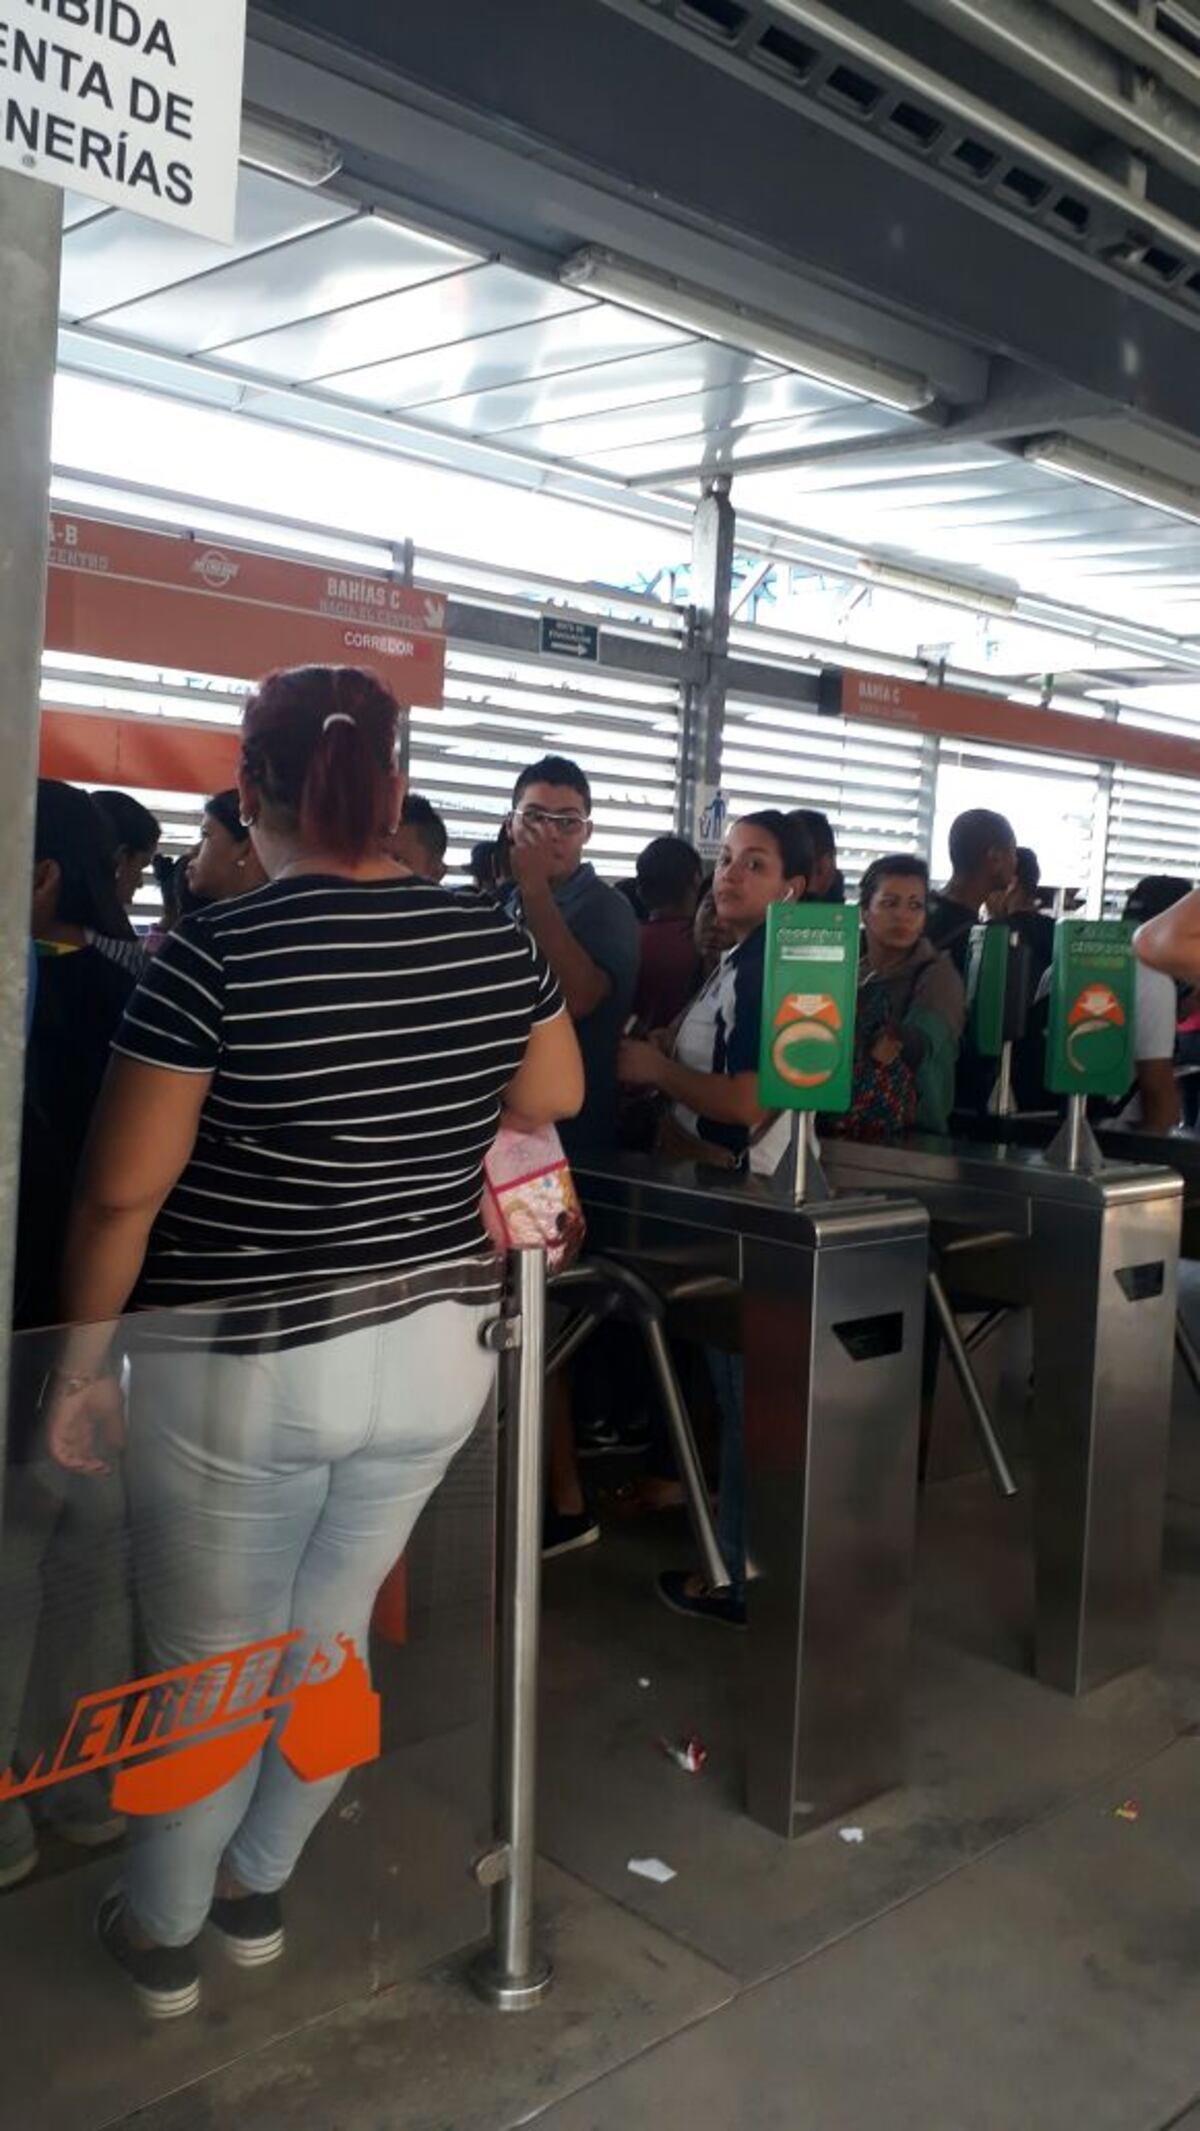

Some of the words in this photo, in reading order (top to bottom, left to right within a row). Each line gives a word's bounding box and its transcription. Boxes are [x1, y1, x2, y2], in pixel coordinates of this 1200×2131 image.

[129, 76, 194, 140] DE
[327, 577, 386, 607] BAHÍAS
[389, 589, 401, 610] C
[344, 631, 415, 657] CORREDOR
